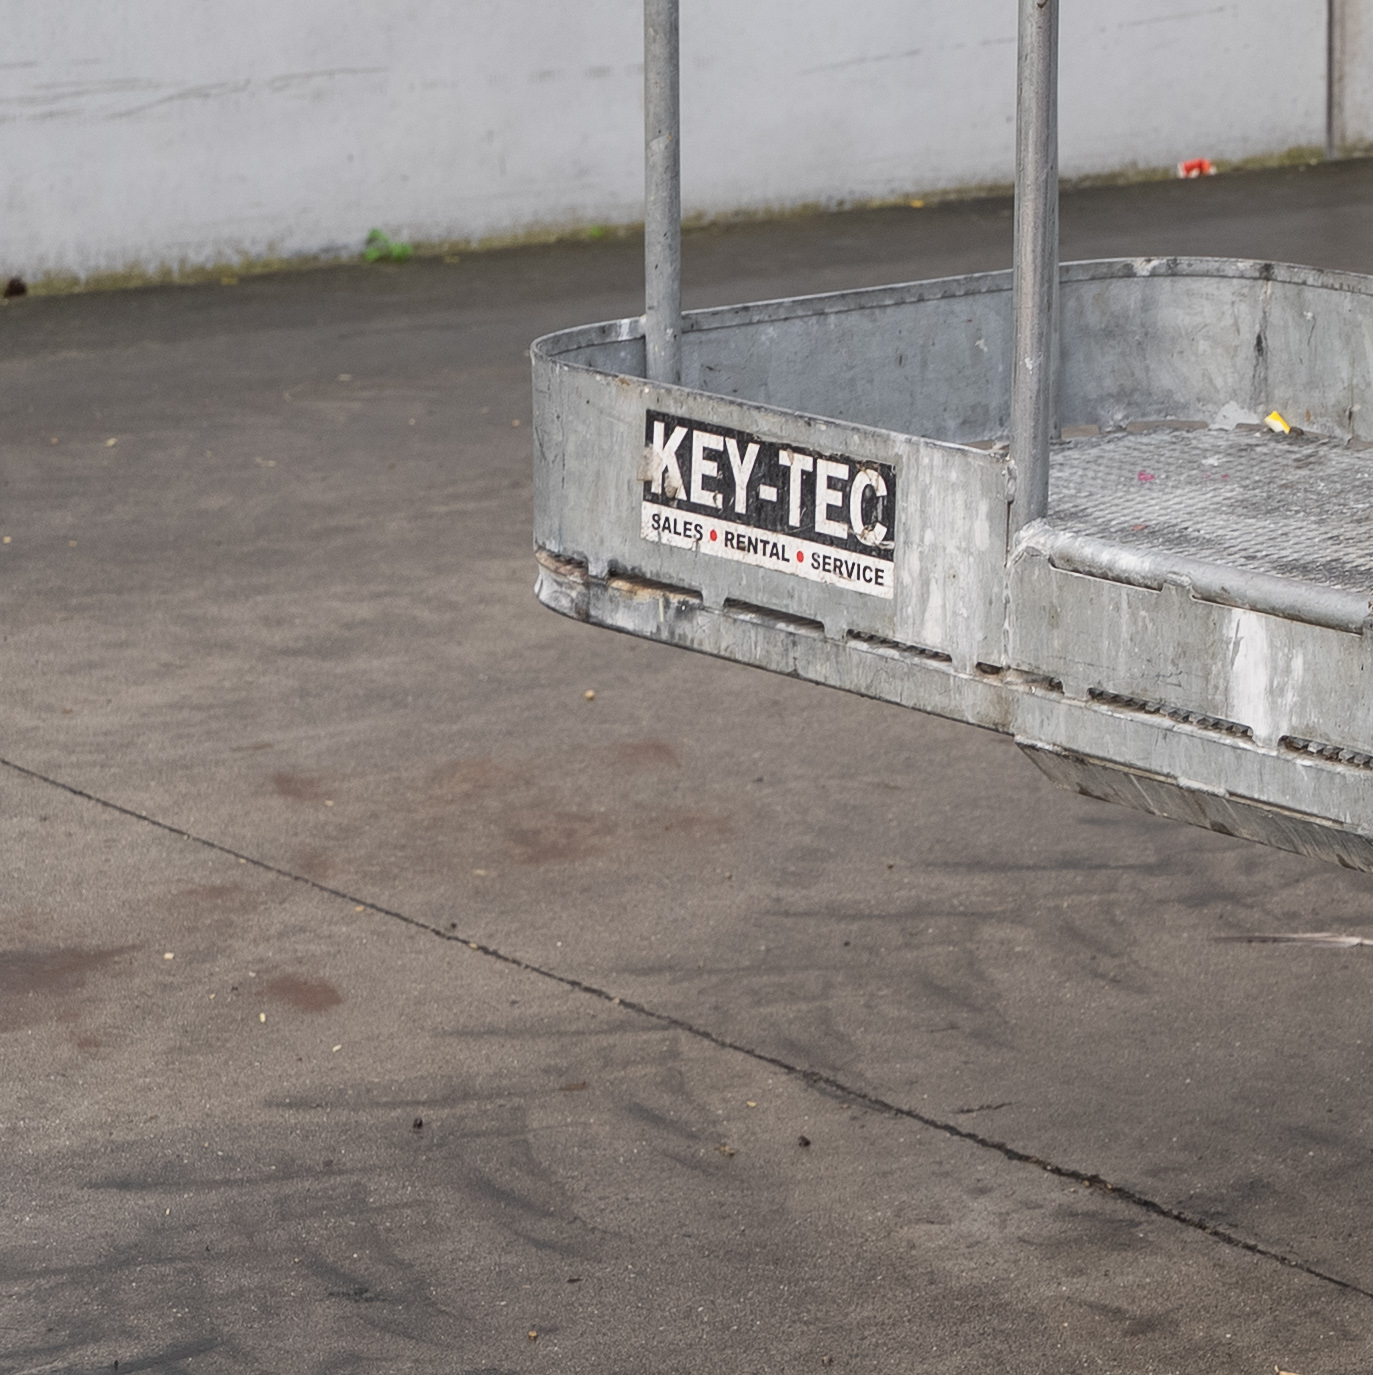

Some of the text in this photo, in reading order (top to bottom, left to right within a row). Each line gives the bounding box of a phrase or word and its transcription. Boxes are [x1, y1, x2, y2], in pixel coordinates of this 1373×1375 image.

[650, 420, 888, 546] KEY-TEC
[651, 514, 884, 586] SALES RENTAL SERVICE
